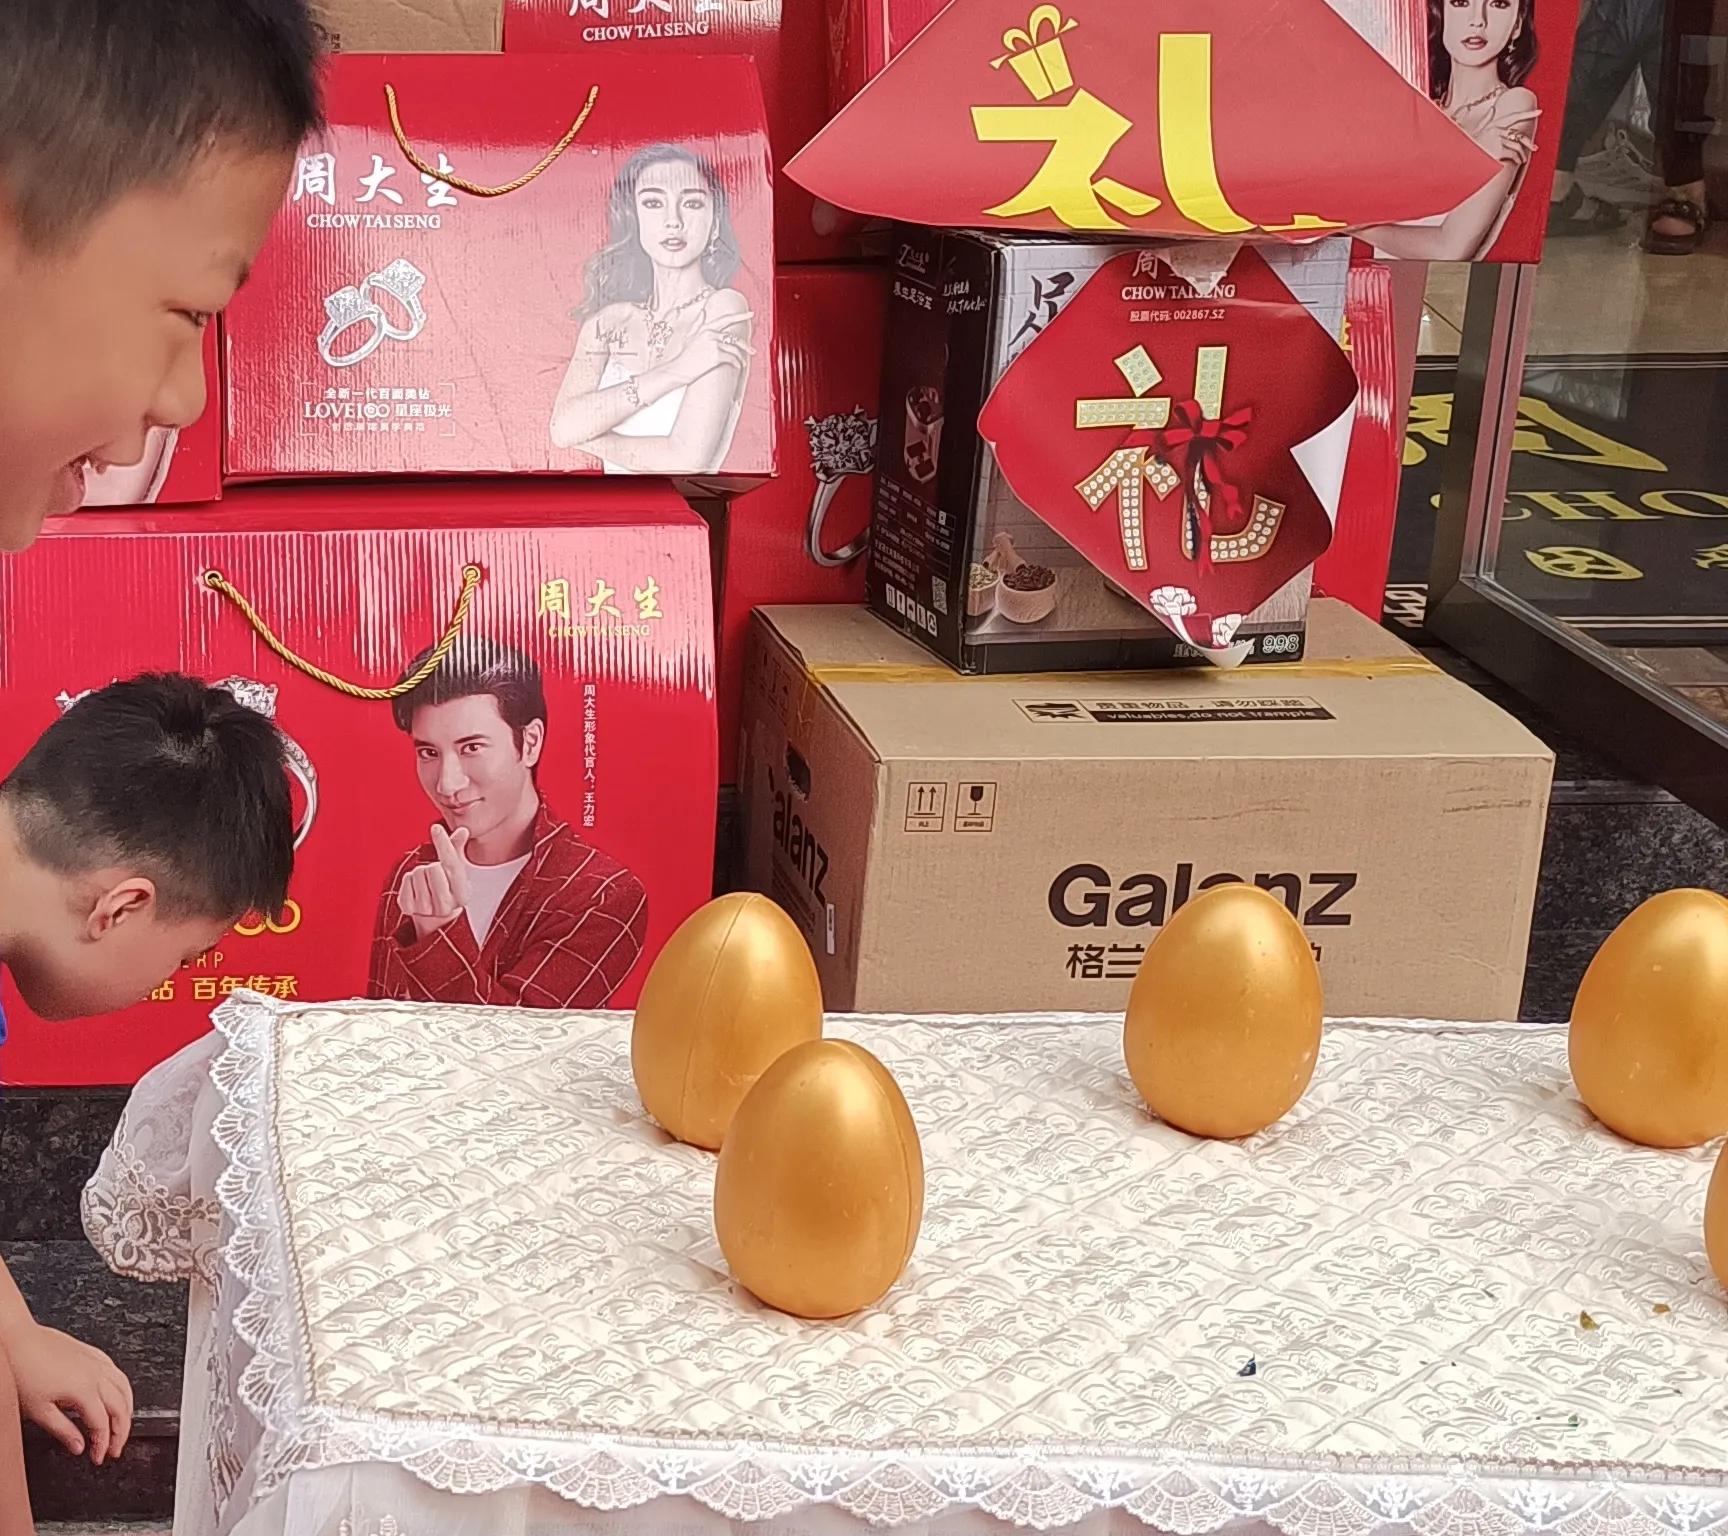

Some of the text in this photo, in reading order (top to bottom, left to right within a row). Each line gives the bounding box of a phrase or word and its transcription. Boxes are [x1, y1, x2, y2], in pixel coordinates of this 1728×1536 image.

[582, 20, 710, 42] CHOW TAI SENG
[292, 152, 459, 208] 周大生
[306, 214, 442, 229] CHOW TAI SENG
[1122, 285, 1166, 300] CHOW
[1171, 285, 1193, 299] TAI
[1174, 309, 1225, 321] 002867.SZ
[539, 575, 663, 619] 周大生
[1262, 633, 1300, 654] 998
[768, 764, 829, 908] alanz
[1048, 863, 1358, 927] Galnz
